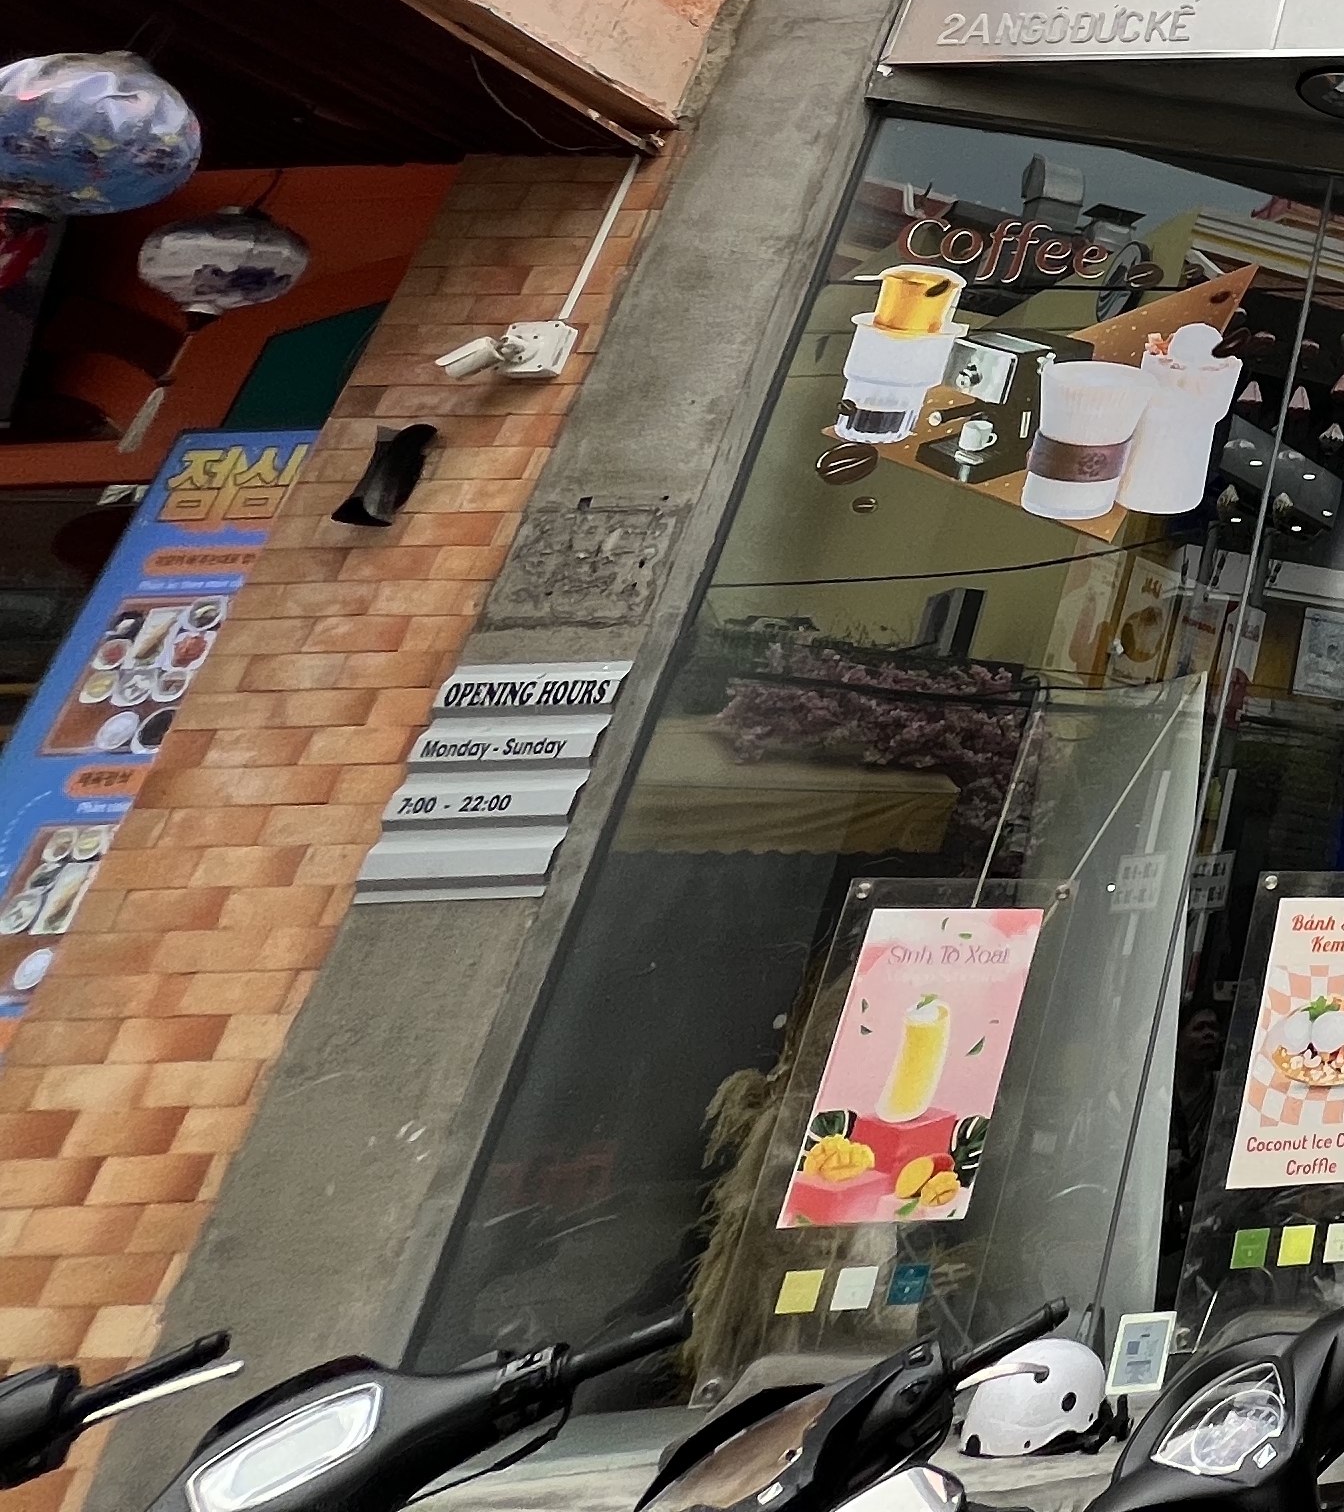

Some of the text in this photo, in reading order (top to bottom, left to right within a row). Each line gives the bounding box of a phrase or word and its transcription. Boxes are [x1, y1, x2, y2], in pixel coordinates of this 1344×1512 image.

[900, 218, 1109, 284] Coffee
[444, 679, 611, 707] OPENING HOURS
[420, 740, 491, 759] Monday
[503, 738, 567, 757] Sunday
[397, 796, 437, 814] 7:00
[458, 794, 512, 813] 22:00
[1291, 913, 1337, 932] Bánh
[1246, 1134, 1308, 1153] Coconut
[1312, 1133, 1333, 1150] Ice
[1286, 1157, 1338, 1176] Croffle
